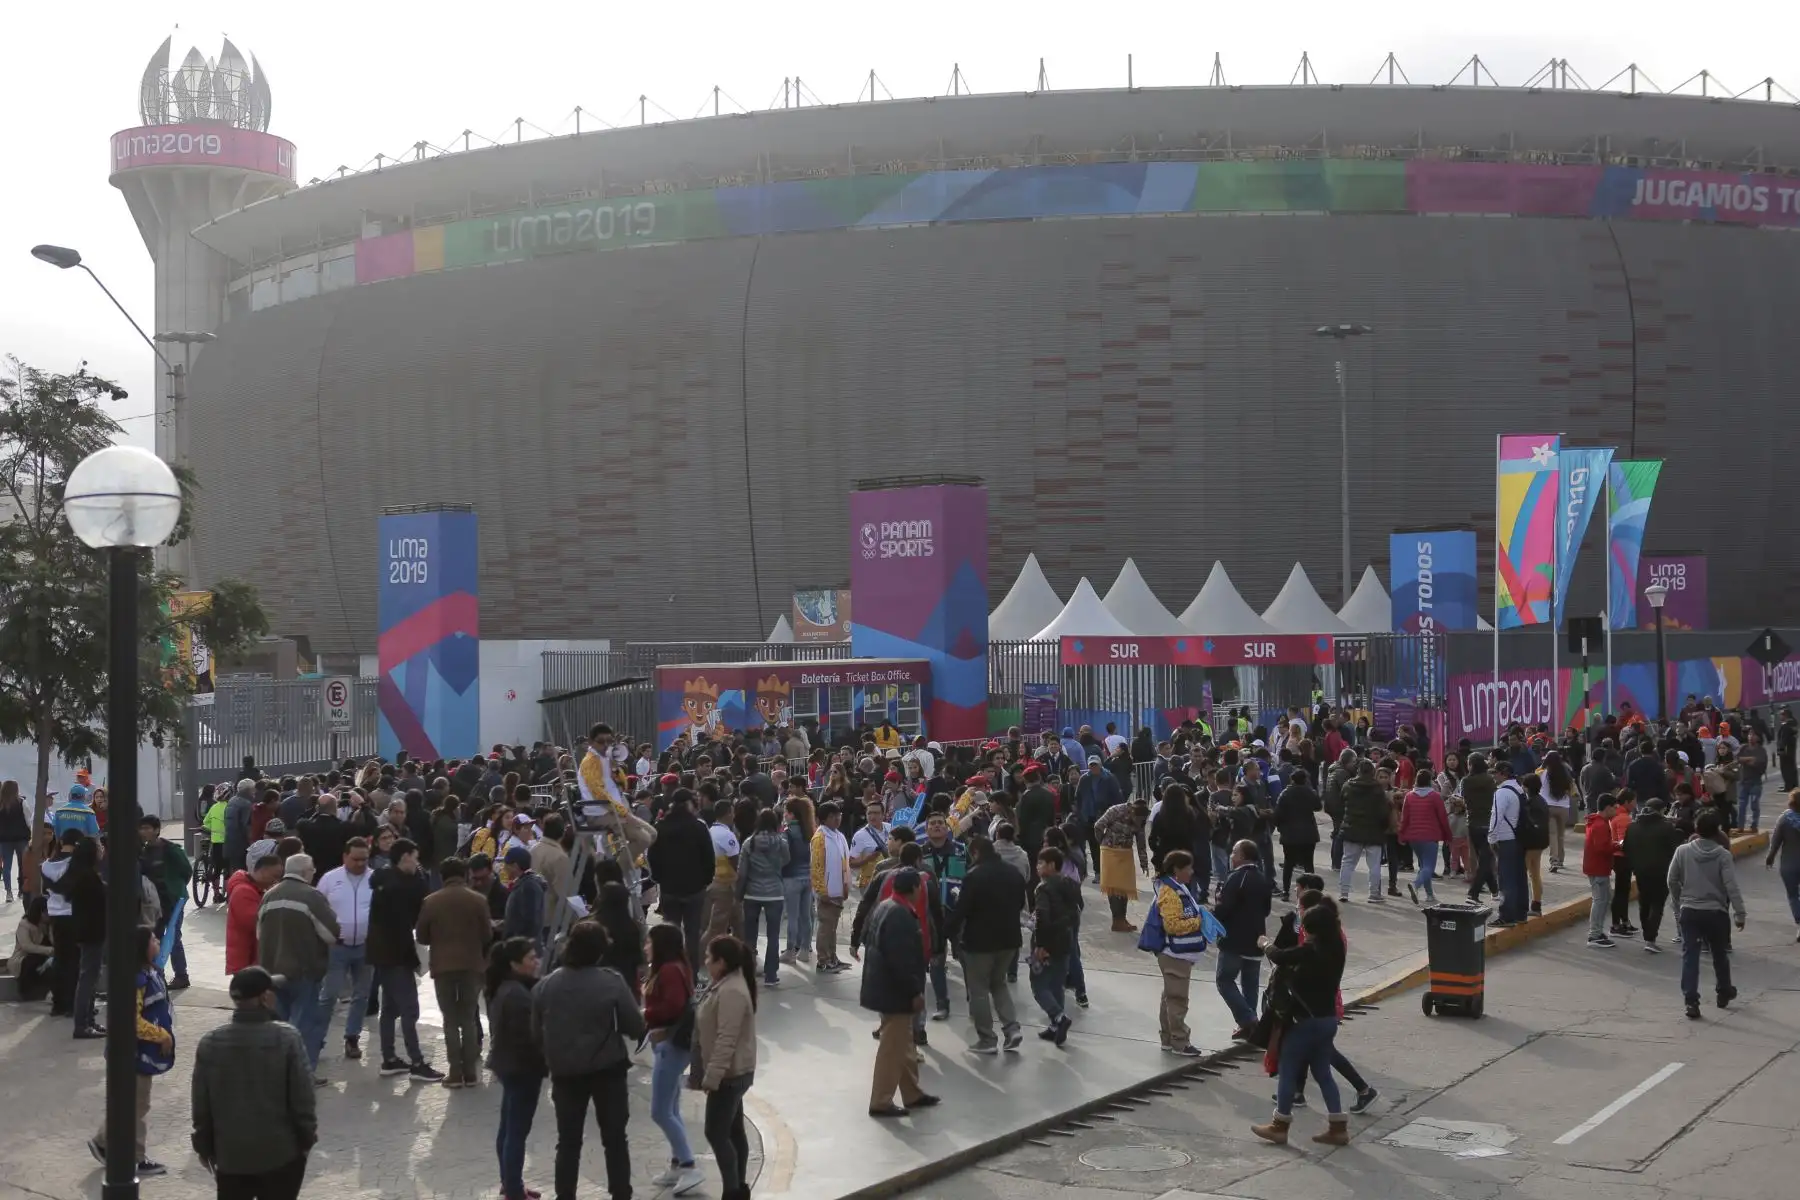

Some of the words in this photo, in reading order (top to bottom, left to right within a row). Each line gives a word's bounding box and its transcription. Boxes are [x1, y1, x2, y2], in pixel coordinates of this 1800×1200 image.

[1632, 178, 1769, 212] JUGAMOS
[1778, 187, 1800, 214] T
[880, 520, 932, 539] PANAM
[880, 539, 935, 558] SPORTS
[390, 561, 428, 583] 2019
[1417, 541, 1433, 611] TODOS
[1650, 576, 1686, 590] 2019
[1110, 643, 1139, 659] SUR
[1243, 642, 1277, 659] SUR
[801, 671, 841, 684] Boletería
[845, 672, 870, 682] Ticket
[871, 671, 886, 681] Box
[887, 670, 910, 680] Office
